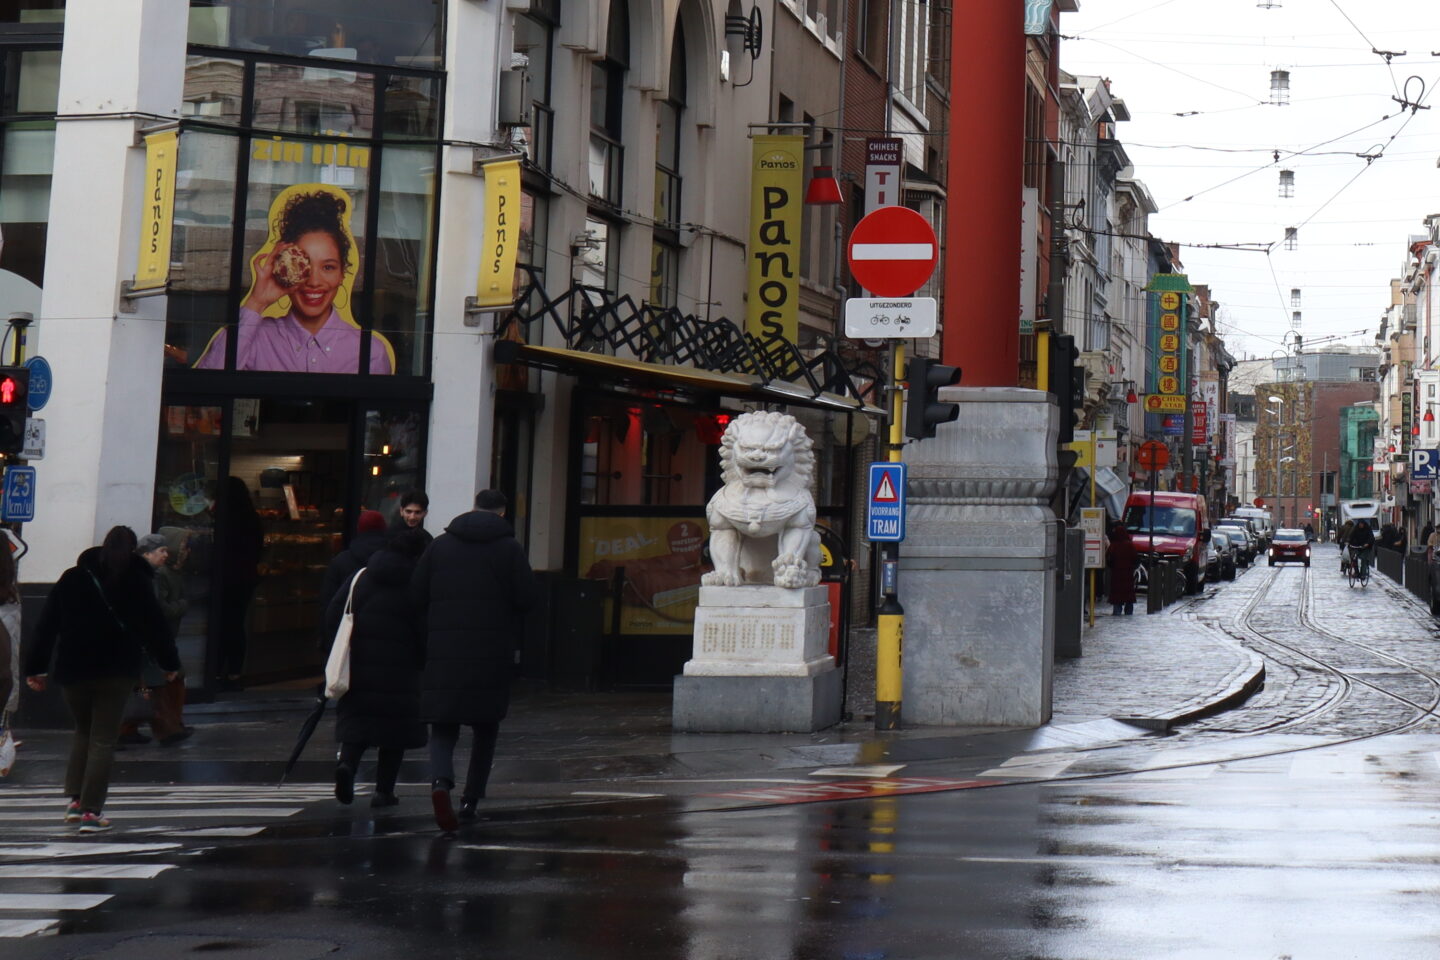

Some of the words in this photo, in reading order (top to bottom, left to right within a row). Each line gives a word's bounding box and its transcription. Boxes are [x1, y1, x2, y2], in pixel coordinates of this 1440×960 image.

[869, 142, 898, 151] CHINESE
[760, 159, 795, 169] Panos
[870, 153, 897, 162] SNACKS
[151, 167, 163, 254] Panos
[493, 195, 507, 274] Panos
[755, 186, 793, 339] Panos
[1414, 451, 1430, 471] P
[8, 499, 32, 515] km/u
[871, 506, 899, 516] VOORRANG
[680, 524, 689, 537] 2
[872, 519, 897, 534] TRAM
